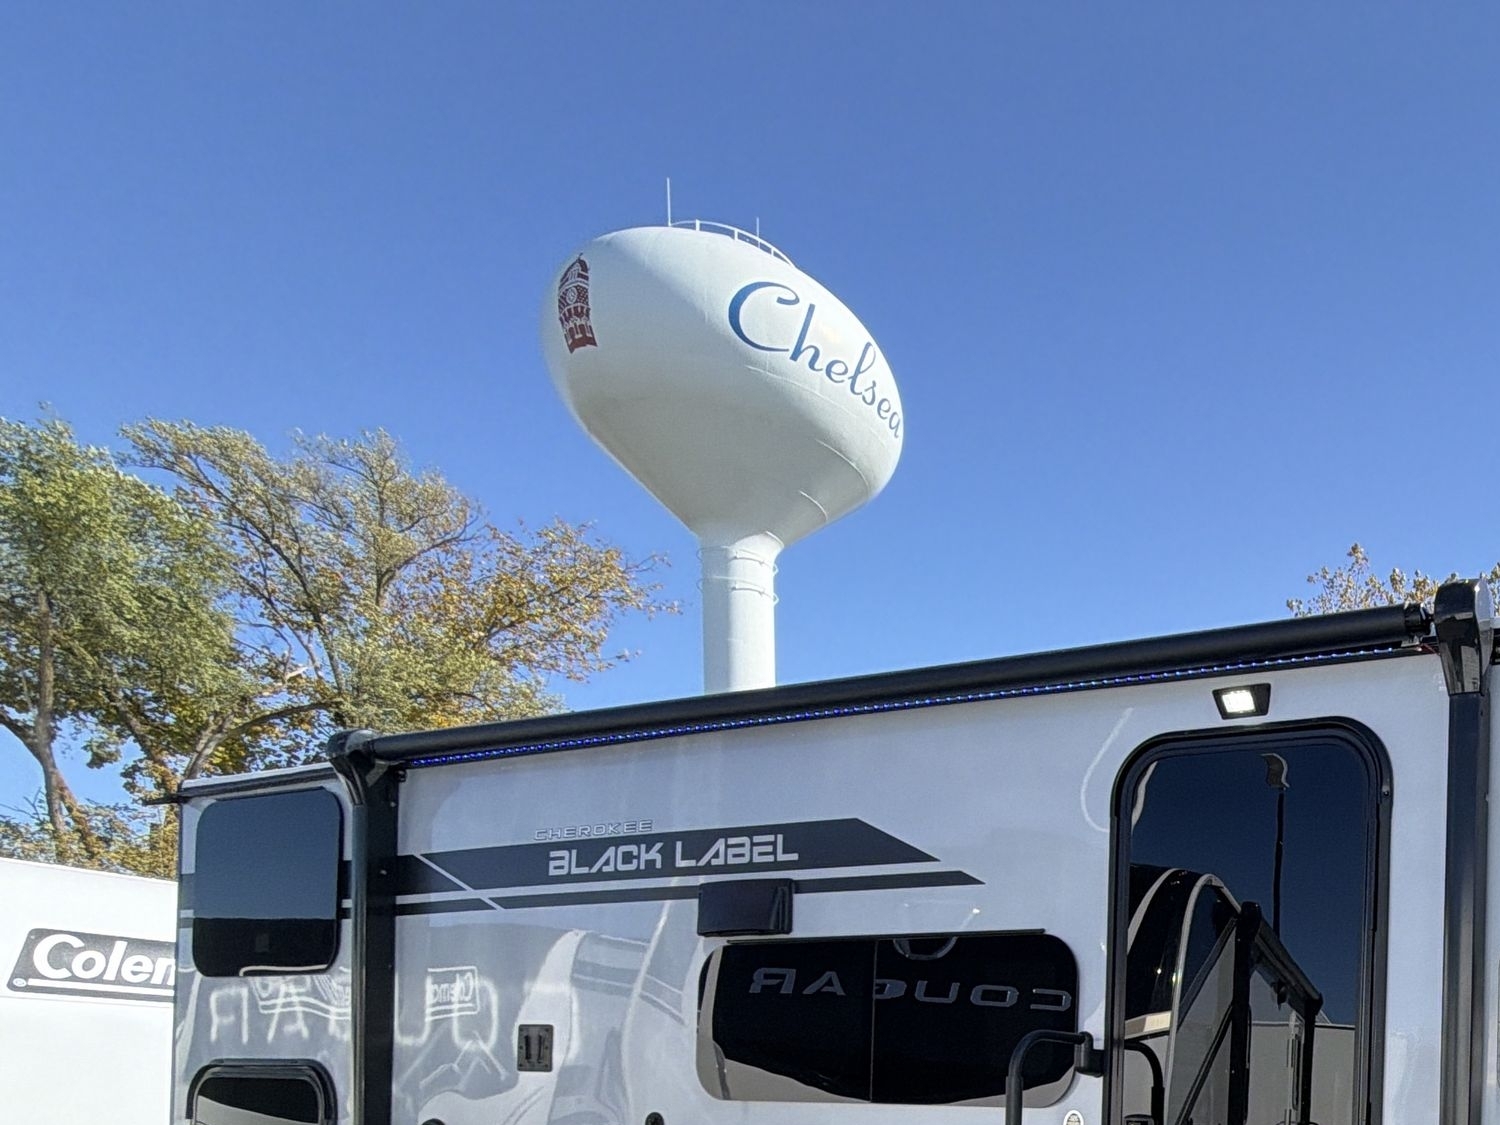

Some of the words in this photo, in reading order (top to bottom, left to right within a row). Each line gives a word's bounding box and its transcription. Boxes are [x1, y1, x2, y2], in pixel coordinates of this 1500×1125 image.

[728, 281, 901, 438] Chelsea
[534, 819, 654, 841] CHEROKEE
[548, 842, 664, 876] BLACK
[675, 833, 799, 868] LABEL
